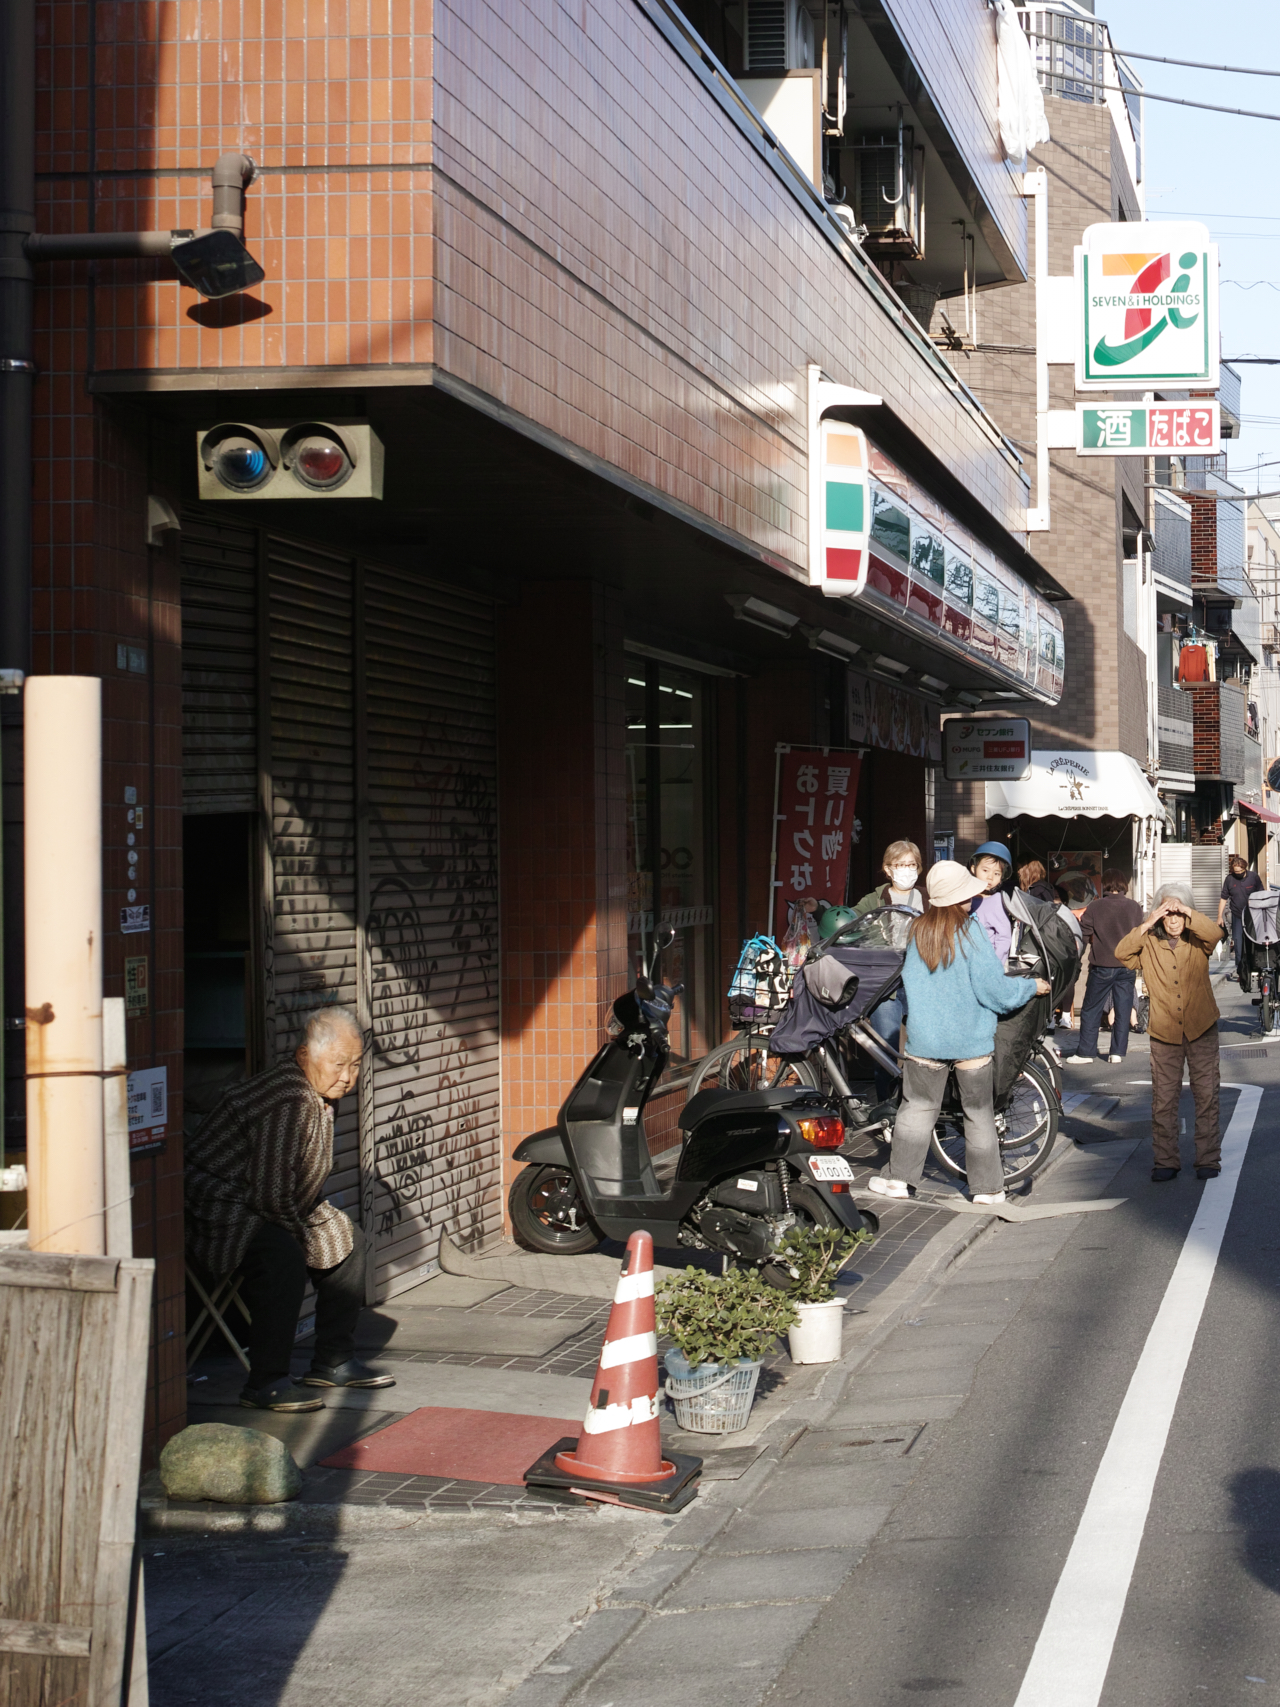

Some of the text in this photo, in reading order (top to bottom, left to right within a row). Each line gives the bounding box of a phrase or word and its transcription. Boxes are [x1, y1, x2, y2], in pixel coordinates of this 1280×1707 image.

[1143, 294, 1200, 306] HOLDINGS
[1096, 410, 1132, 447] 酒
[1151, 409, 1211, 446] たばこ
[726, 1128, 761, 1136] TACT
[822, 1167, 851, 1177] 10013
